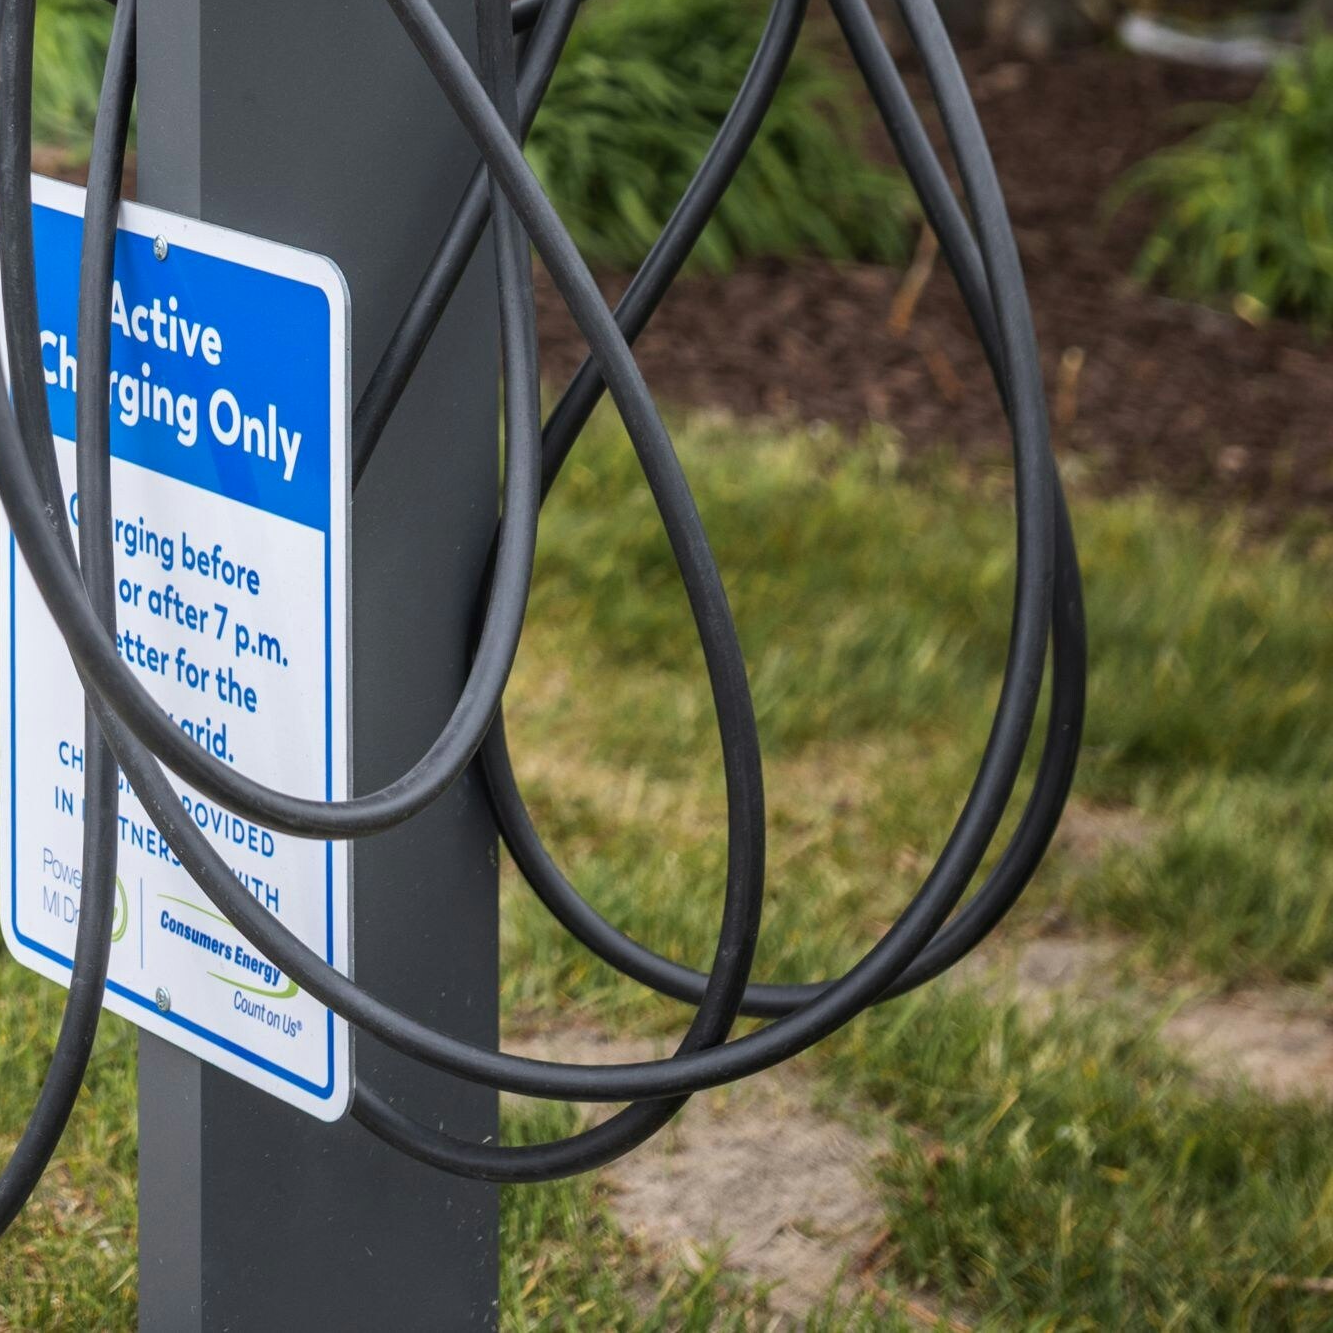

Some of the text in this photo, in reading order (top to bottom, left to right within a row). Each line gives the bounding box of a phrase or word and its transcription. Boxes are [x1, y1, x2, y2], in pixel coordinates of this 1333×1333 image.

[110, 280, 223, 366] Active
[40, 330, 302, 482] Chrging Only
[182, 531, 261, 596] before
[118, 578, 289, 668] or after 7 p.m.
[116, 629, 258, 714] etter for the
[54, 785, 280, 914] IN ITH
[181, 794, 275, 858] OVIDED
[42, 846, 83, 890] Powe
[42, 885, 60, 918] MI
[160, 909, 282, 987] Consumers Energy
[234, 990, 266, 1023] Count
[266, 1010, 281, 1030] on
